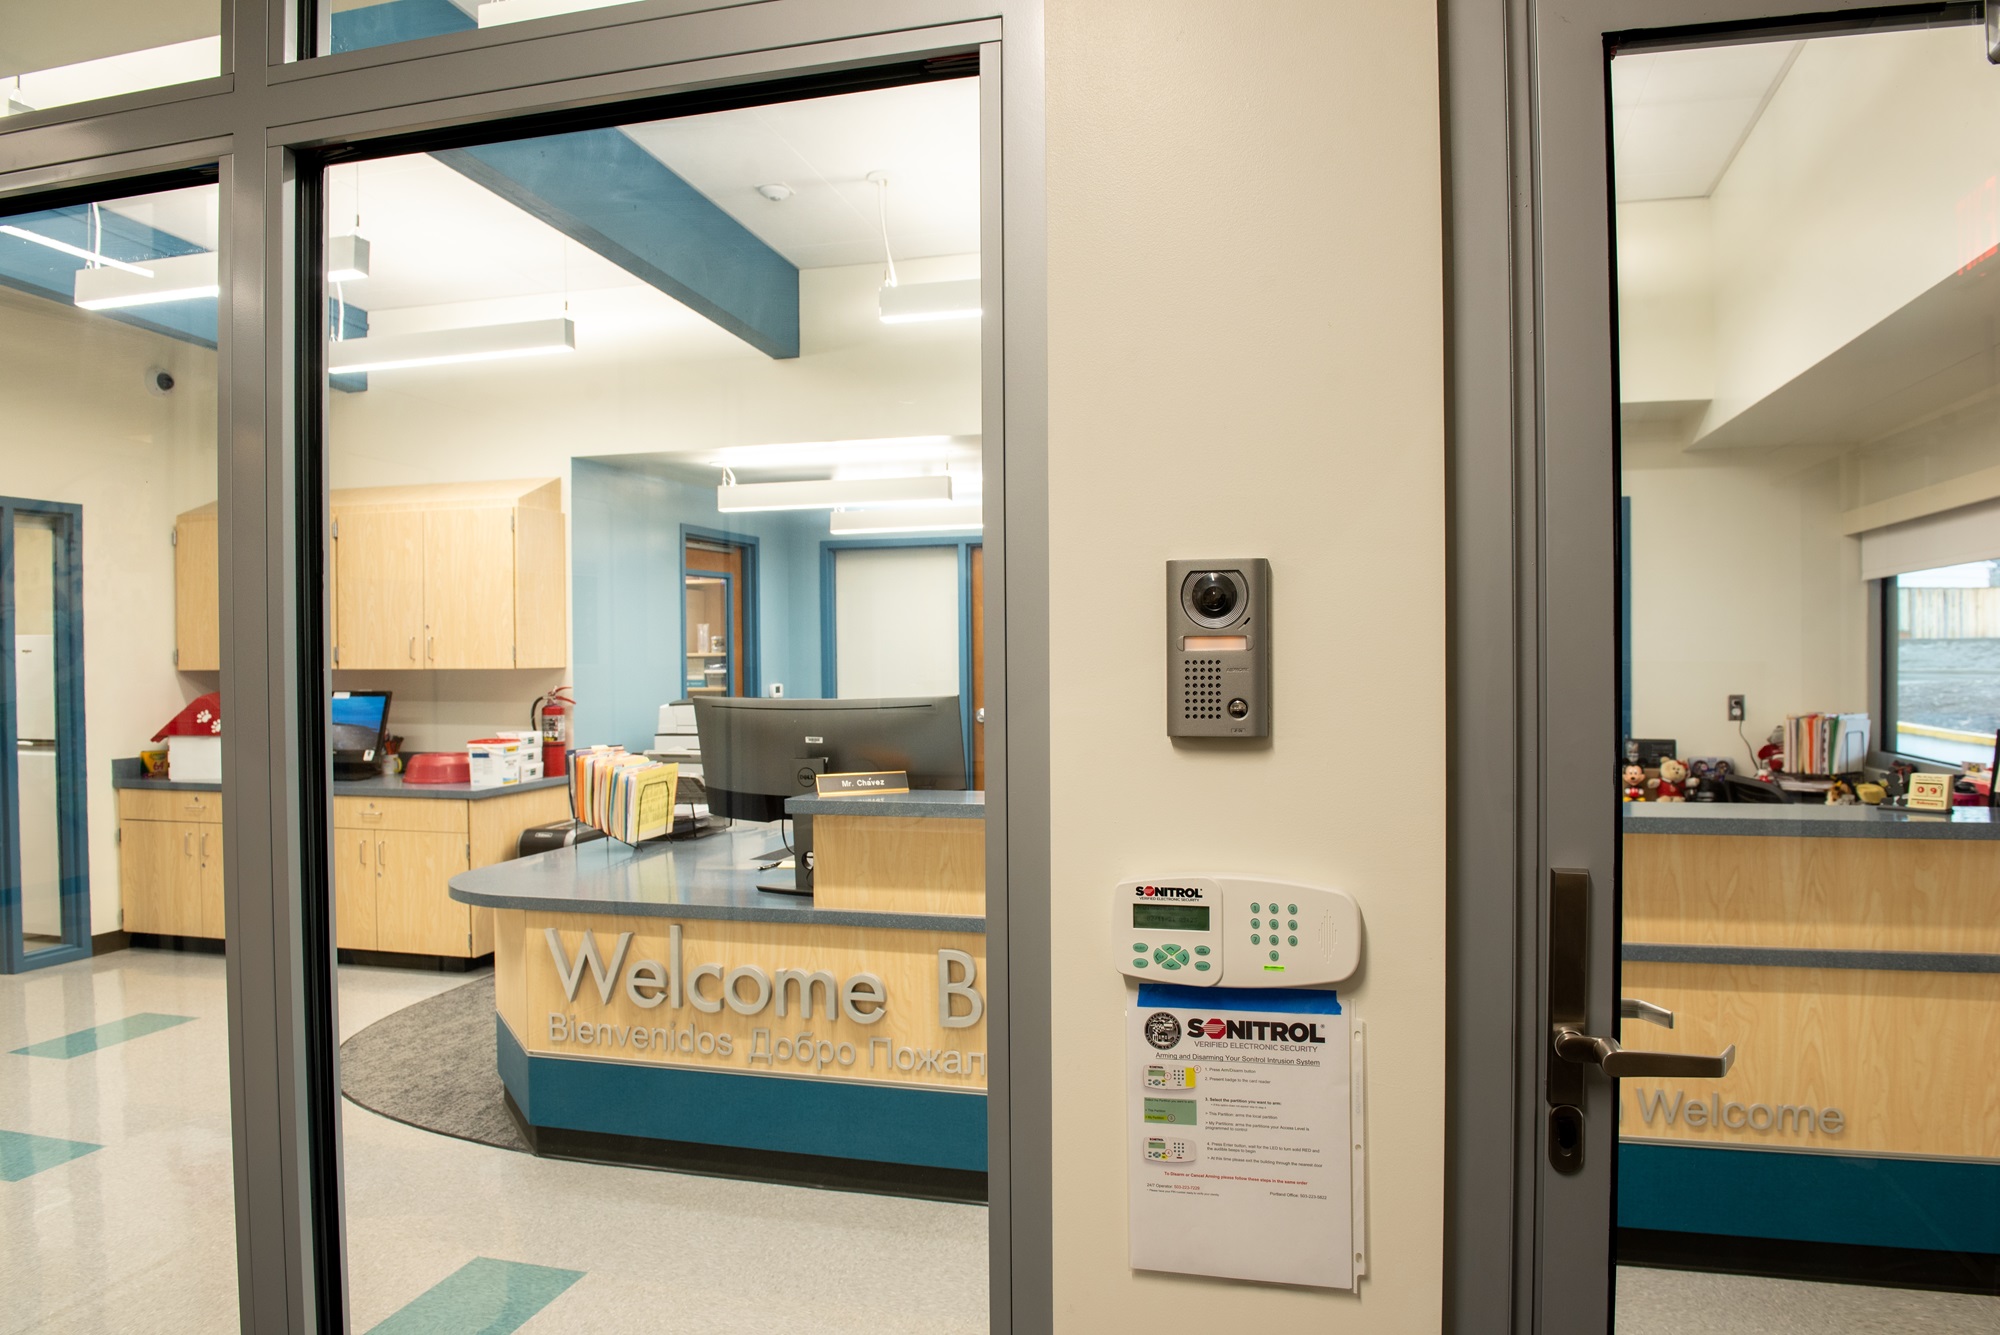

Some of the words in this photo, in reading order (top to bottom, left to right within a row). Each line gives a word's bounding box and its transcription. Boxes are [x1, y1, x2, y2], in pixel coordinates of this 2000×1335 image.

[153, 761, 164, 771] 64
[856, 777, 885, 787] Chávez
[1136, 886, 1202, 898] SONITROL
[544, 924, 888, 1025] Welcome
[938, 949, 984, 1028] B
[548, 1012, 735, 1056] Bienvenidos
[1186, 1018, 1326, 1044] SONITROL
[748, 1027, 857, 1072] Добро
[868, 1035, 986, 1076] Пожал
[1194, 1040, 1228, 1048] VERIFIED
[1230, 1042, 1278, 1051] ELECTRONIC
[1280, 1044, 1318, 1052] SECURITY
[1156, 1052, 1178, 1060] Arming
[1192, 1054, 1224, 1062] Disarming
[1296, 1058, 1320, 1066] System
[1636, 1087, 1845, 1135] Welcome
